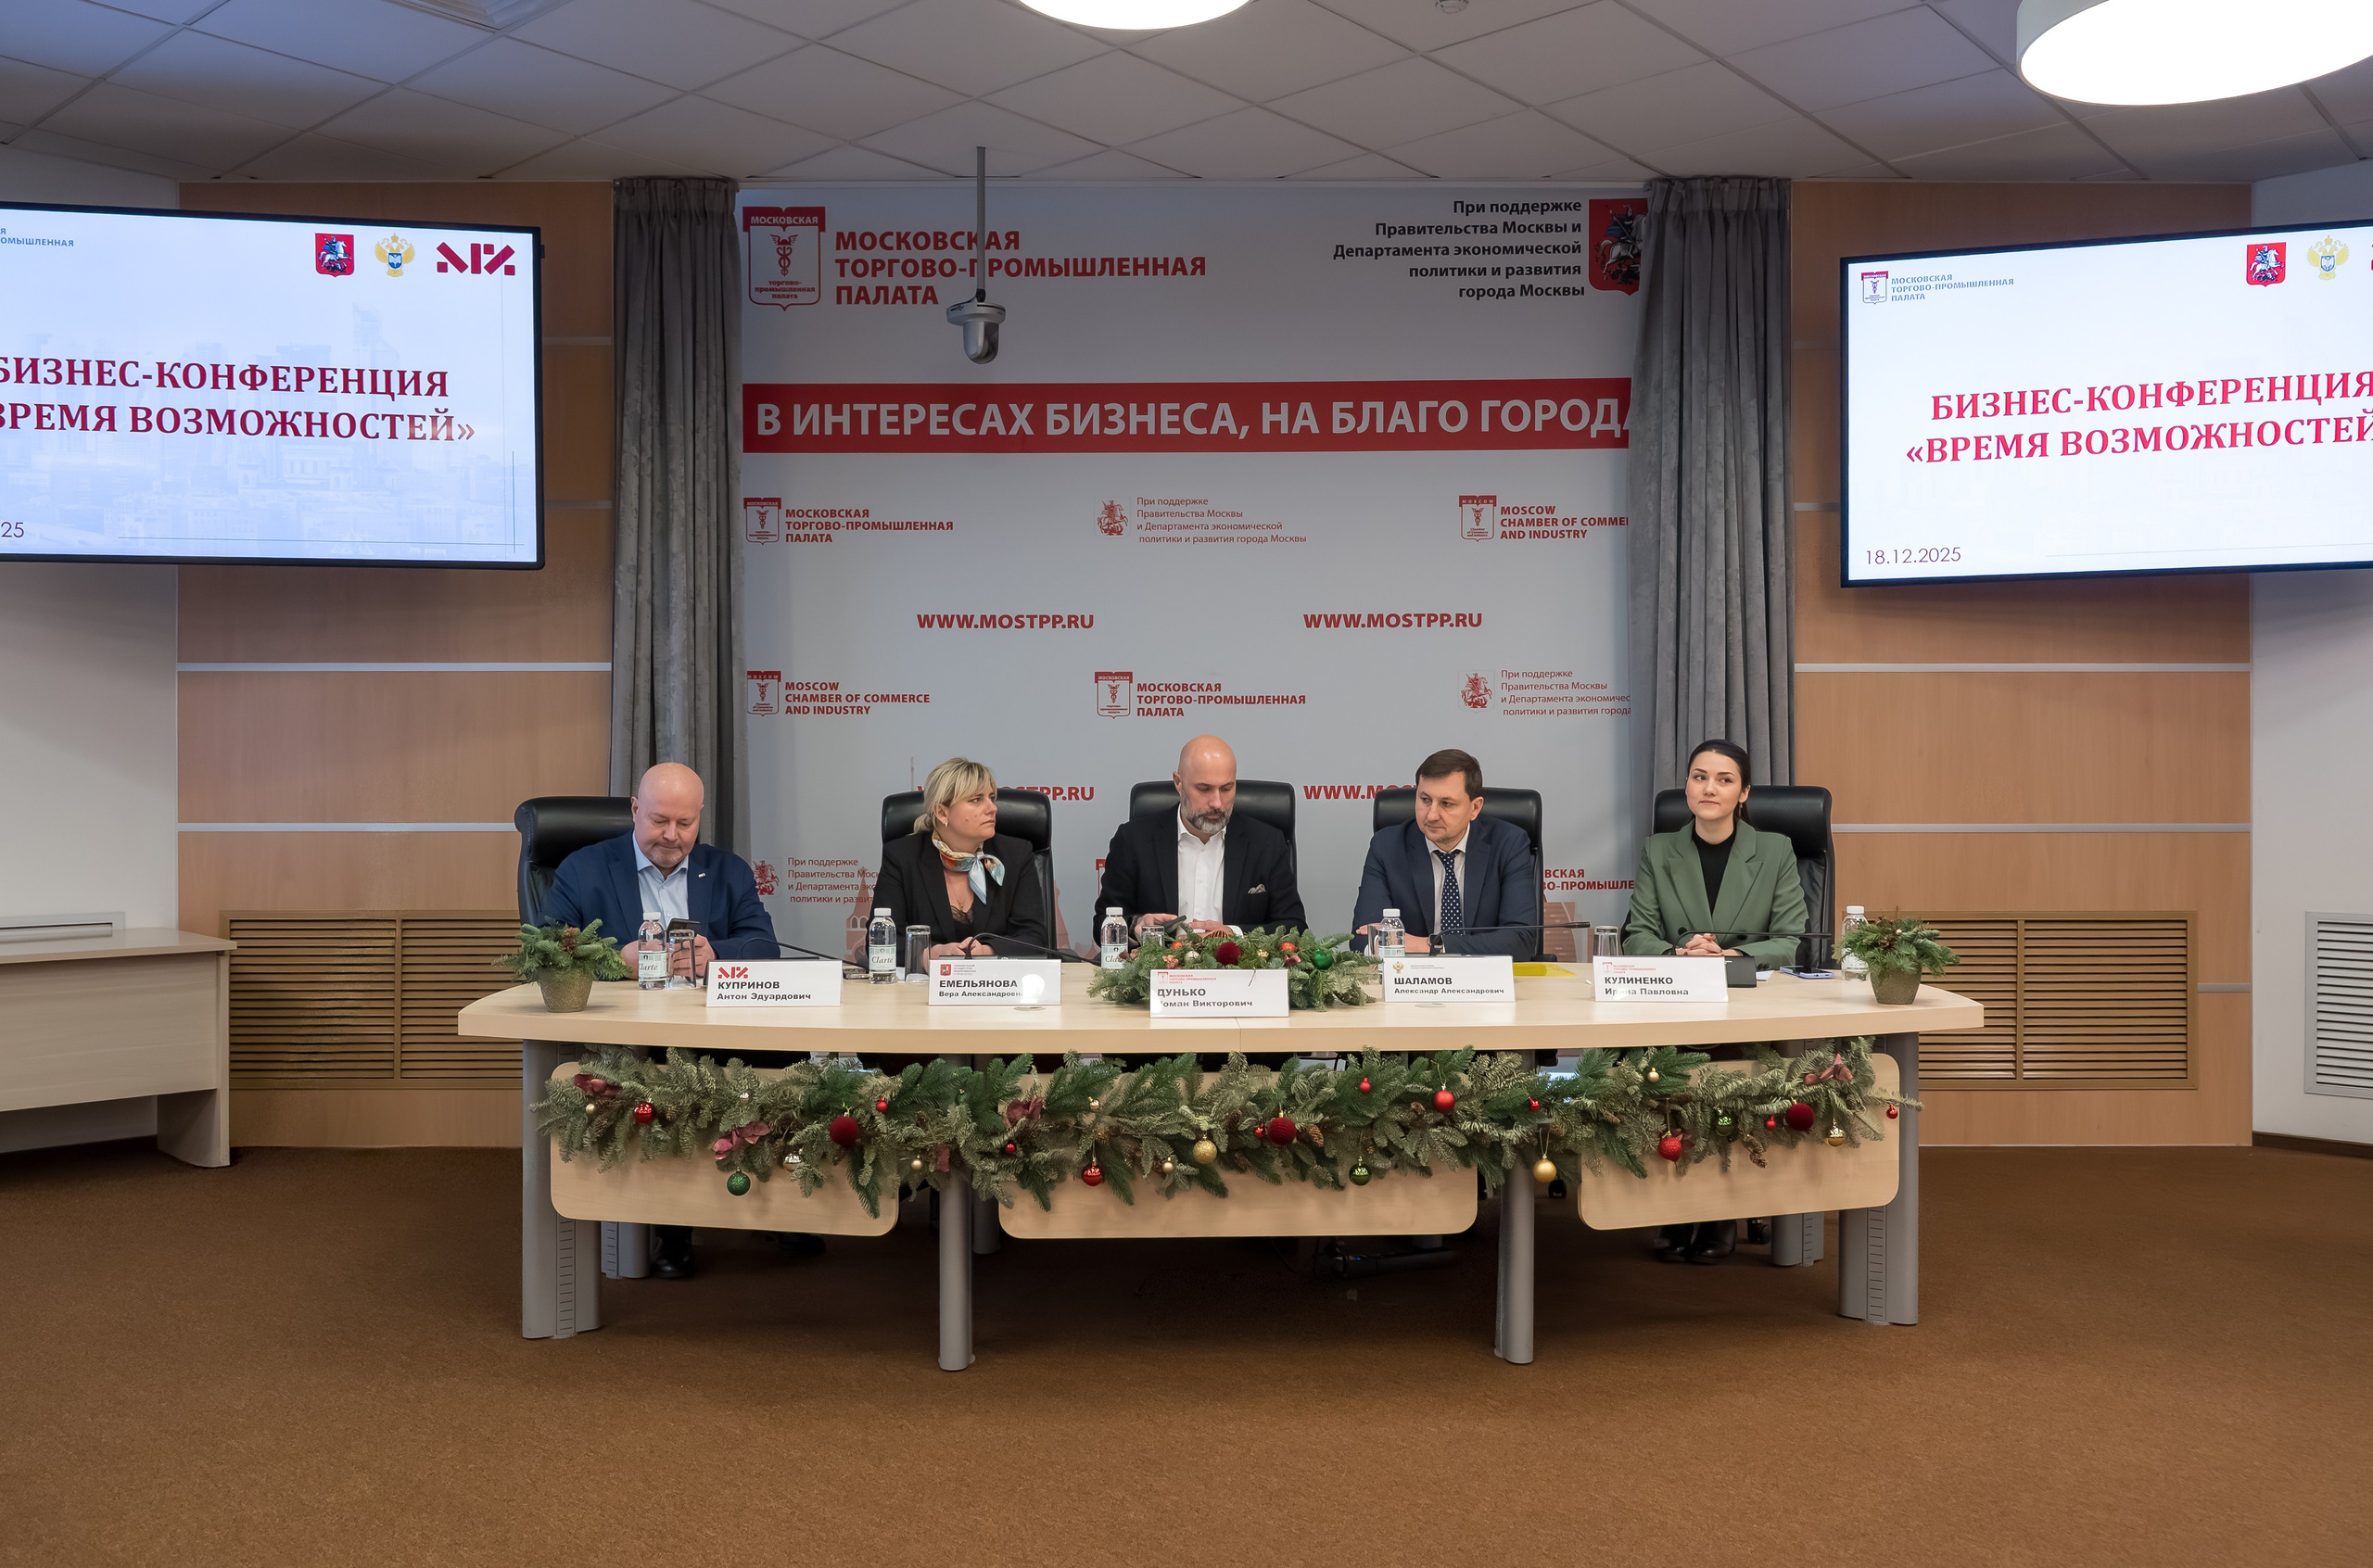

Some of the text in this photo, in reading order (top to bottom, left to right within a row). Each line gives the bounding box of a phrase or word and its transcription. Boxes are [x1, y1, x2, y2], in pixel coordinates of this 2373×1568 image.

[1453, 200, 1582, 217] При поддержке
[751, 216, 818, 224] МОСКОВСКАЯ
[1376, 221, 1581, 239] Правительства Москвы и
[835, 231, 1020, 251] МОСКОВСКАЯ
[1333, 241, 1582, 260] Департамента экономической
[1409, 264, 1581, 279] политики и развития
[1892, 274, 1952, 285] МОСКОВСКАЯ
[1891, 279, 2014, 293] ТОРГОВО-ПРОМЫШЛЕННАЯ
[836, 285, 939, 305] ПАЛАТА
[1459, 284, 1585, 301] города Москвы
[1891, 294, 1925, 302] ПАЛАТА
[1931, 371, 2373, 421] БИЗНЕС-КОНФЕРЕНЦИЯ
[0, 402, 476, 441] РЕМЯ ВОЗМОЖНОСТЕЙ»
[757, 398, 1631, 440] В ИНТЕРЕСАХ БИЗНЕСА, НА БЛАГО ГОРОД
[1906, 430, 2049, 463] «ВРЕМЯ
[1136, 497, 1209, 507] При поддержке
[785, 509, 869, 518] МОСКОВСКАЯ
[1136, 510, 1243, 520] Правительства Москвы
[1501, 506, 1555, 515] MOSCOW
[785, 521, 954, 531] ТОРГОВО-ПРОМЫШЛЕННАЯ
[1501, 516, 1629, 527] CHAMBER OF COMME
[1145, 523, 1209, 532] Департамента
[1212, 522, 1283, 530] экономической
[785, 533, 832, 543] ПАЛАТА
[1500, 529, 1588, 539] AND INDUSTRY
[1192, 536, 1234, 544] развития
[1237, 536, 1268, 544] города
[1270, 535, 1307, 543] Москвы
[1865, 547, 1961, 565] 18.12.2025
[917, 614, 1094, 629] WWW.MOSTPP.RU
[1303, 613, 1482, 628] WWW.MOSTPP.RU
[1501, 669, 1572, 680] При поддержке
[785, 682, 839, 690] MOSCOW
[1136, 683, 1222, 692] МОСКОВСКАЯ
[1501, 681, 1607, 692] Правительства Москвы
[785, 694, 930, 703] CHAMBER OF COMMERCE
[1136, 695, 1306, 704] ТОРГОВО-ПРОМЫШЛЕННАЯ
[1508, 695, 1573, 705] Департамента
[785, 705, 870, 714] AND INDUSTRY
[1136, 707, 1185, 716] ПАЛАТА
[1504, 708, 1546, 716] политики
[1557, 707, 1598, 716] развития
[788, 857, 858, 867] При поддержке
[788, 870, 855, 879] Правительства
[795, 882, 859, 891] Департамента
[791, 895, 834, 904] политики
[751, 993, 811, 1001] Эдуардович
[1157, 988, 1206, 997] ДУНЬКО
[1605, 988, 1637, 996] Ирна
[1193, 1000, 1252, 1008] Викторович
